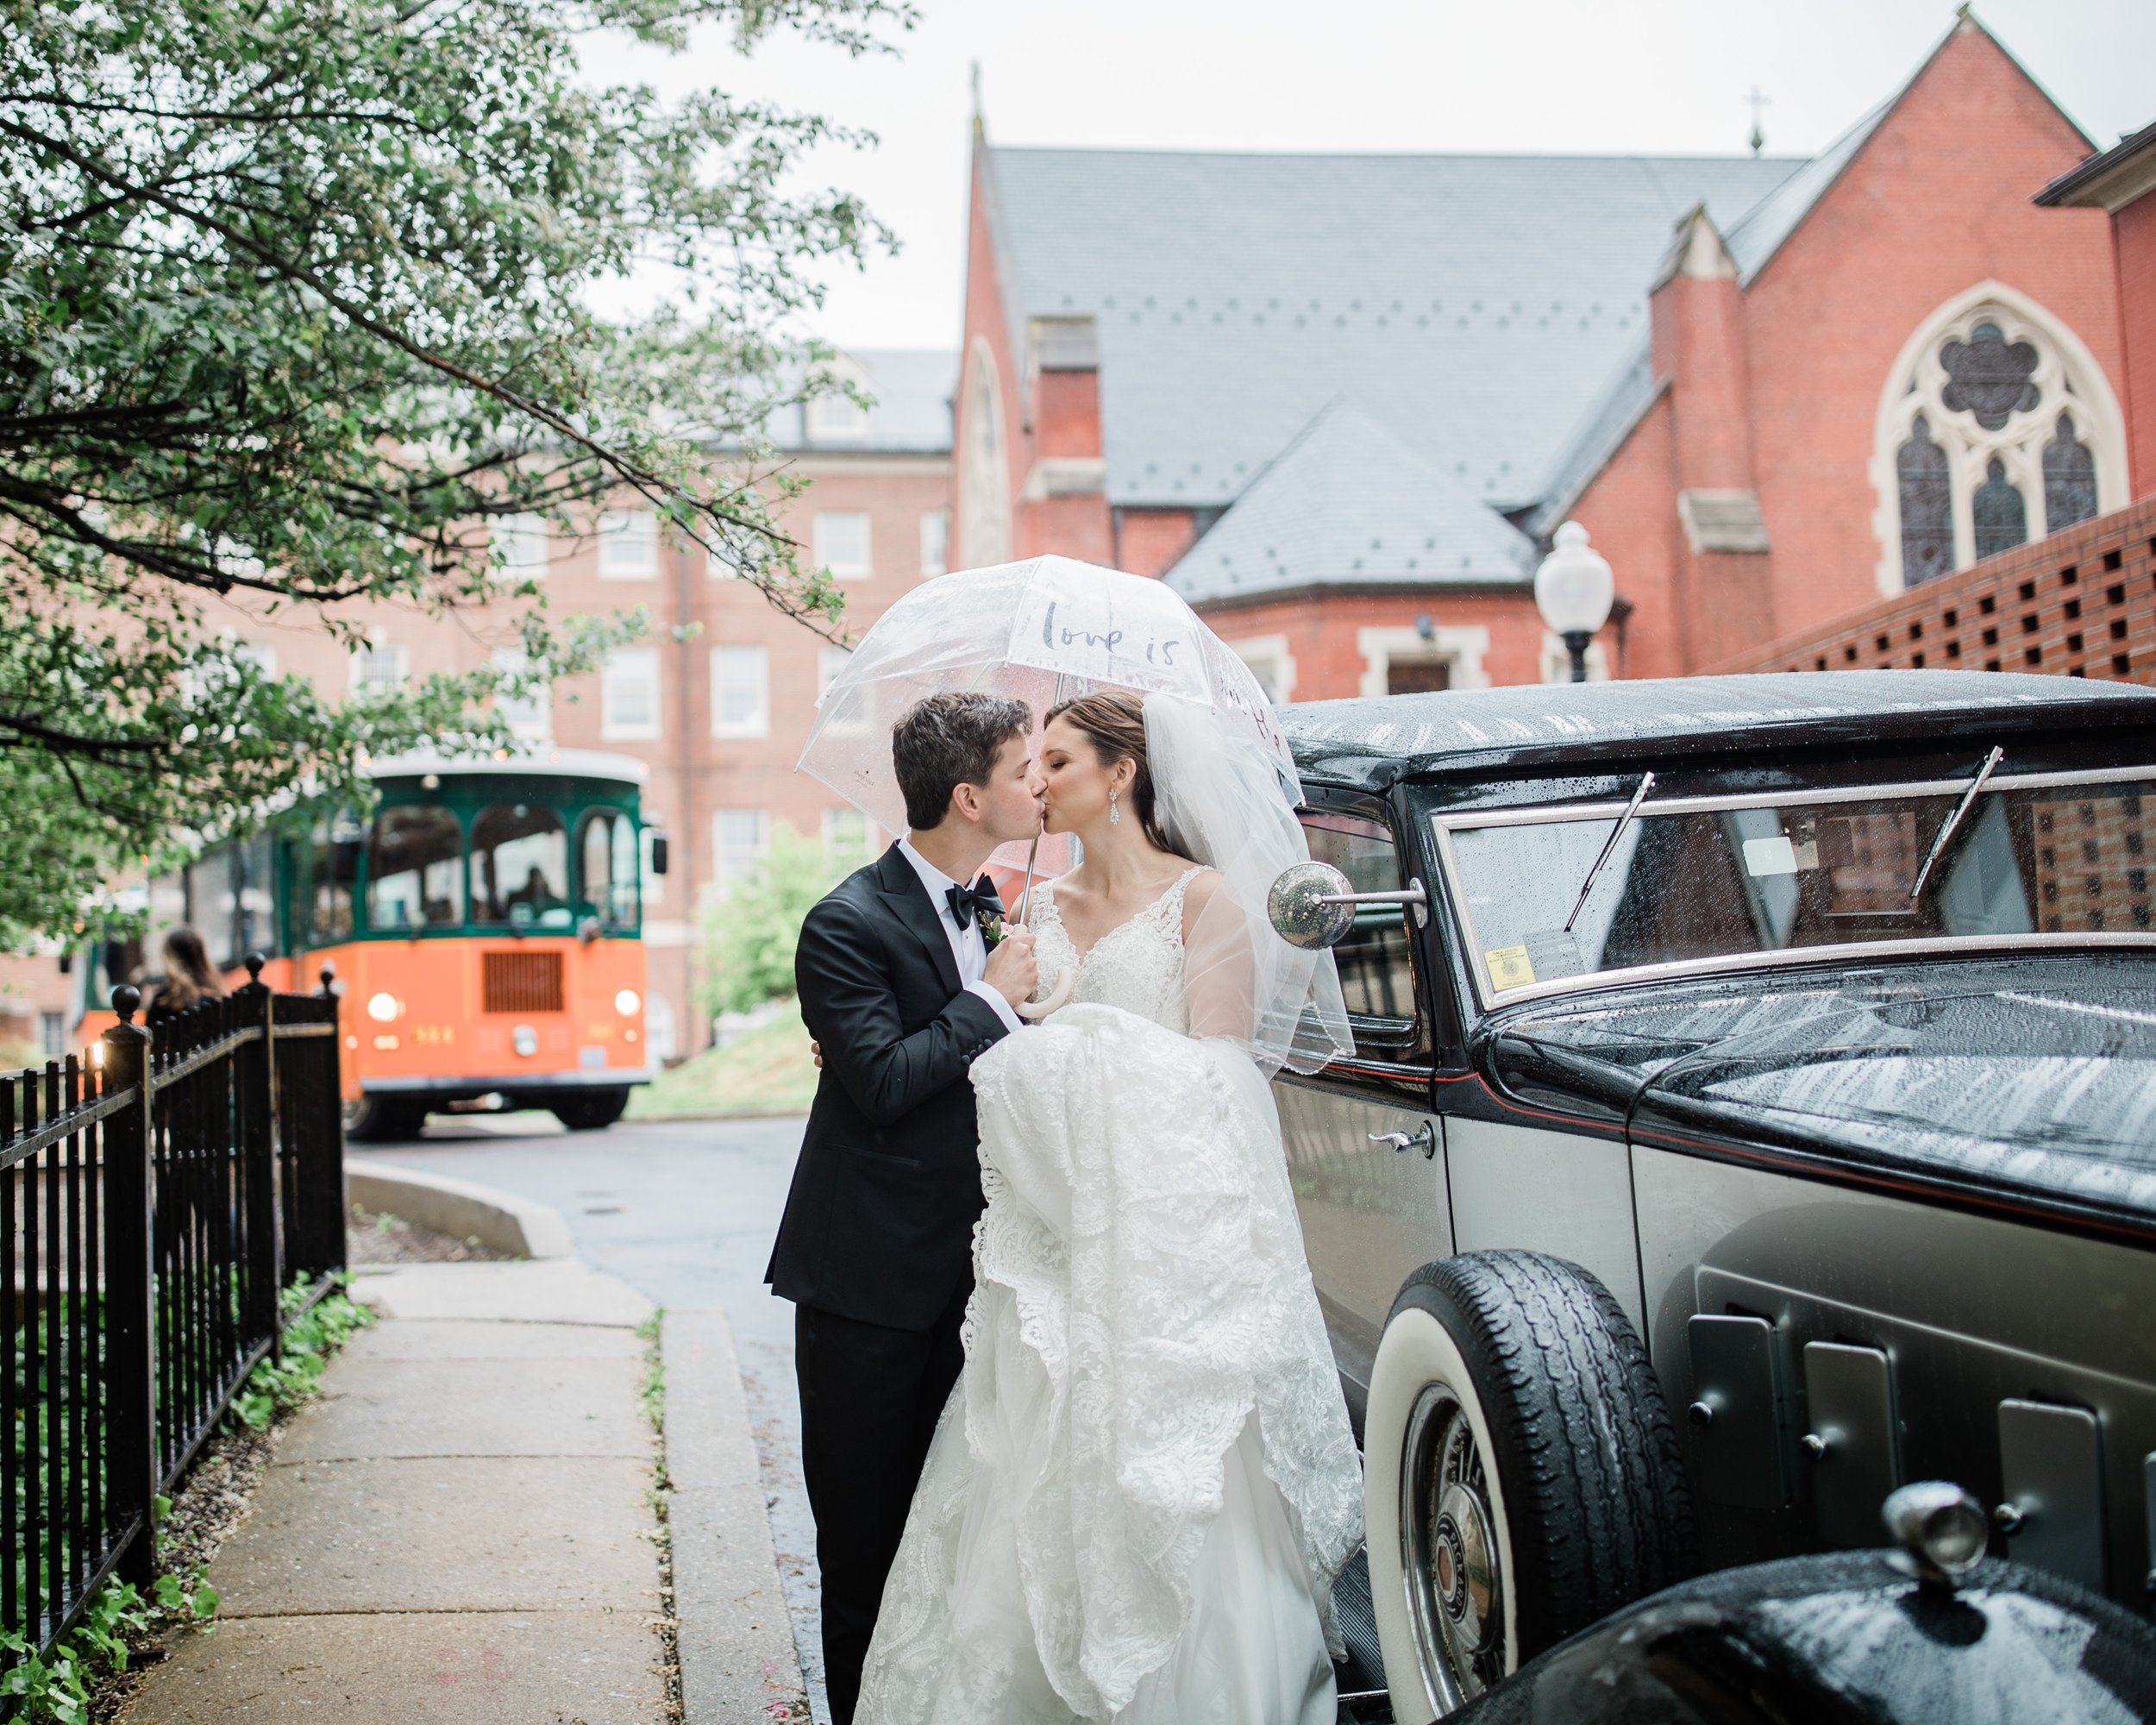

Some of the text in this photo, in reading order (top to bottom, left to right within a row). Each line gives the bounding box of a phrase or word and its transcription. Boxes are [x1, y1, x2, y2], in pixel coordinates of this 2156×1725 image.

[1043, 601, 1179, 666] love is
[1450, 1532, 1463, 1606] PACKARD
